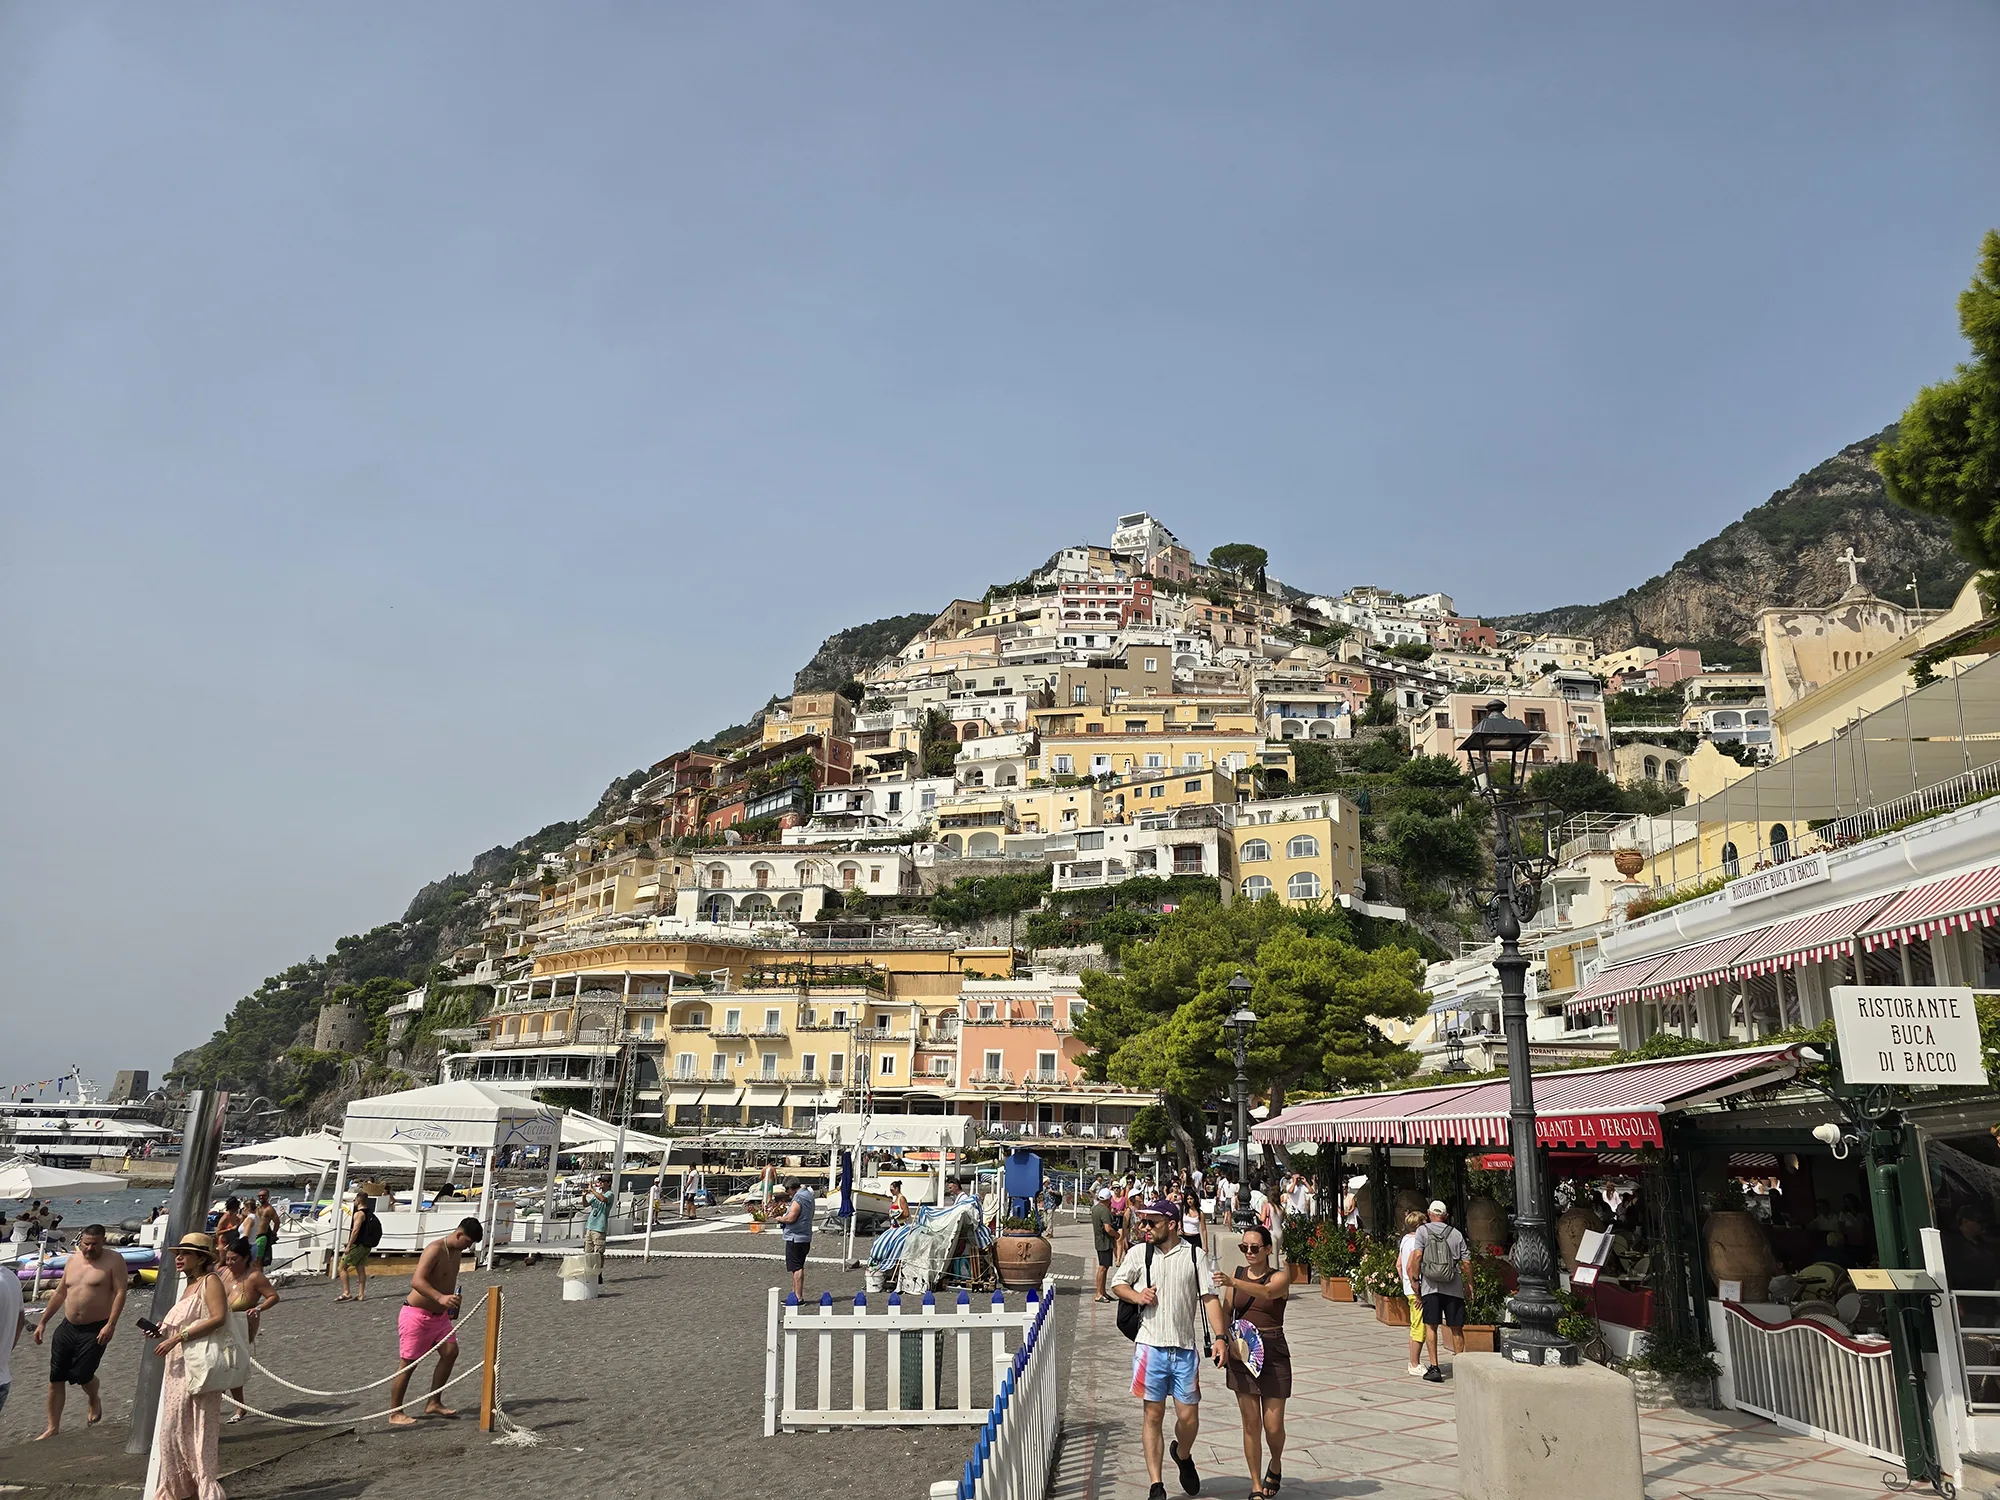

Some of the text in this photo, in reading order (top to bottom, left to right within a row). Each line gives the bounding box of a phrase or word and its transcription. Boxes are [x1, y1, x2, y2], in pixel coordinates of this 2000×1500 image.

[1732, 861, 1819, 900] RISTORANTE BUCA DI BACCO
[1857, 997, 1961, 1019] RISTORANTE
[1891, 1025, 1936, 1045] BUCA
[1878, 1051, 1957, 1072] DI BACCO
[1579, 1119, 1596, 1136] LA
[1600, 1117, 1657, 1137] PERGOLA
